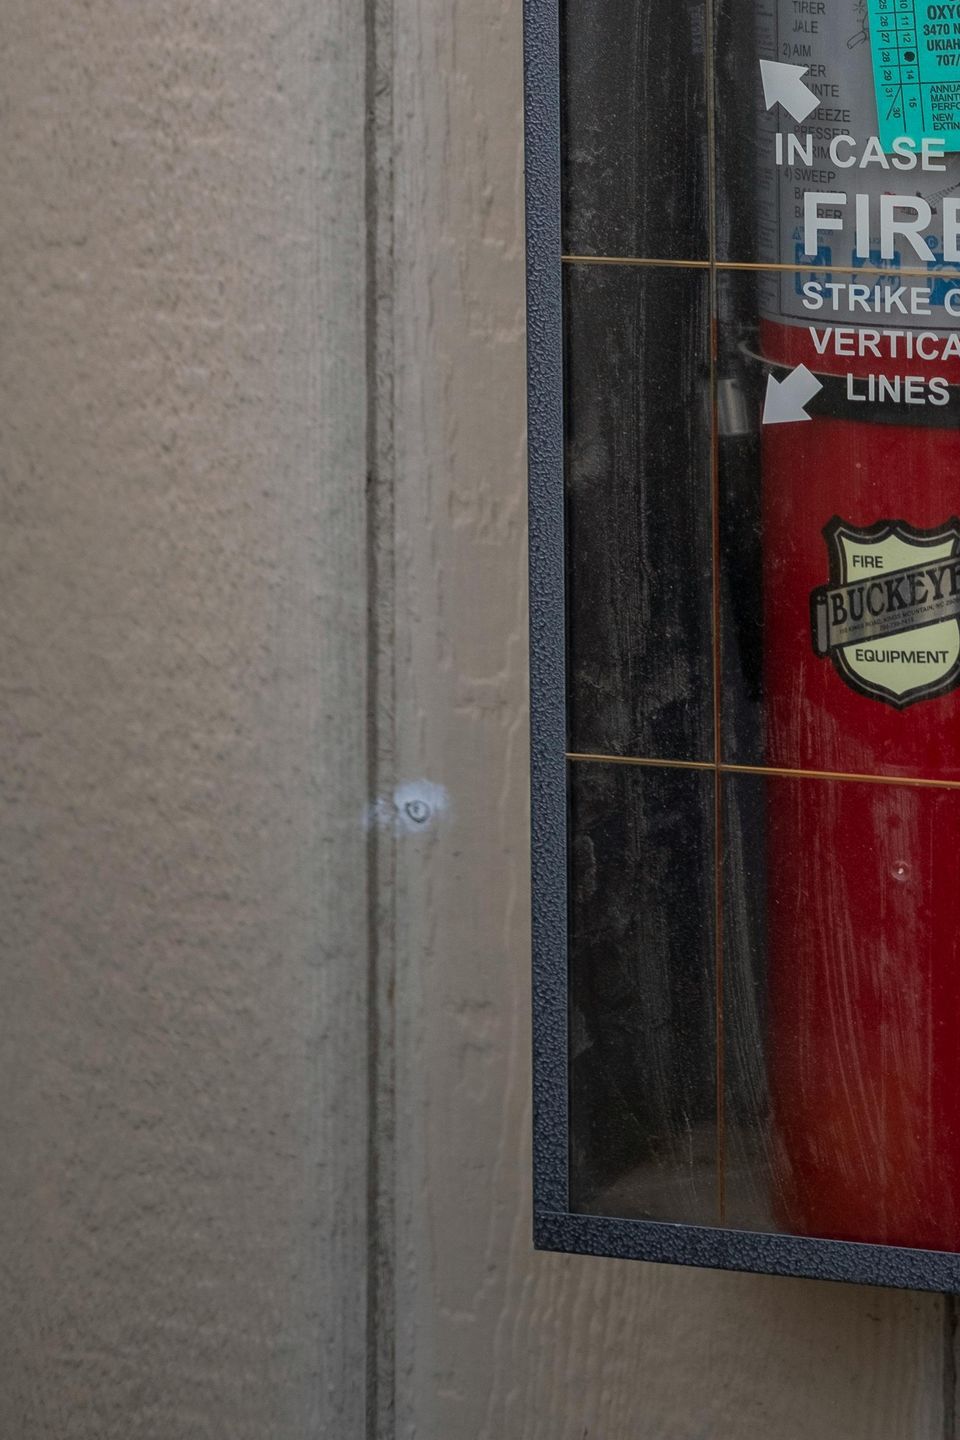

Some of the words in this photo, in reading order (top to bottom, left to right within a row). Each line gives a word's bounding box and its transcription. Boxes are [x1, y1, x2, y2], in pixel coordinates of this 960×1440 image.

[793, 0, 826, 15] TIRER
[880, 16, 888, 27] 26
[901, 16, 909, 25] 11
[792, 20, 819, 34] JALE
[923, 23, 949, 36] 3470
[881, 32, 890, 43] 27
[903, 32, 911, 43] 12
[793, 44, 812, 57] AIM
[882, 51, 890, 62] 28
[884, 70, 892, 81] 29
[906, 69, 914, 80] 14
[885, 87, 893, 98] 31
[909, 98, 917, 108] 15
[893, 107, 900, 119] 30
[932, 113, 954, 122] NEW
[775, 133, 813, 167] IN
[829, 135, 946, 172] CASE
[794, 167, 836, 184] SWEEP
[802, 282, 932, 315] STRIKE
[846, 373, 950, 406] LINES
[852, 555, 883, 569] FIRE
[855, 648, 949, 664] EQUIPMENT
